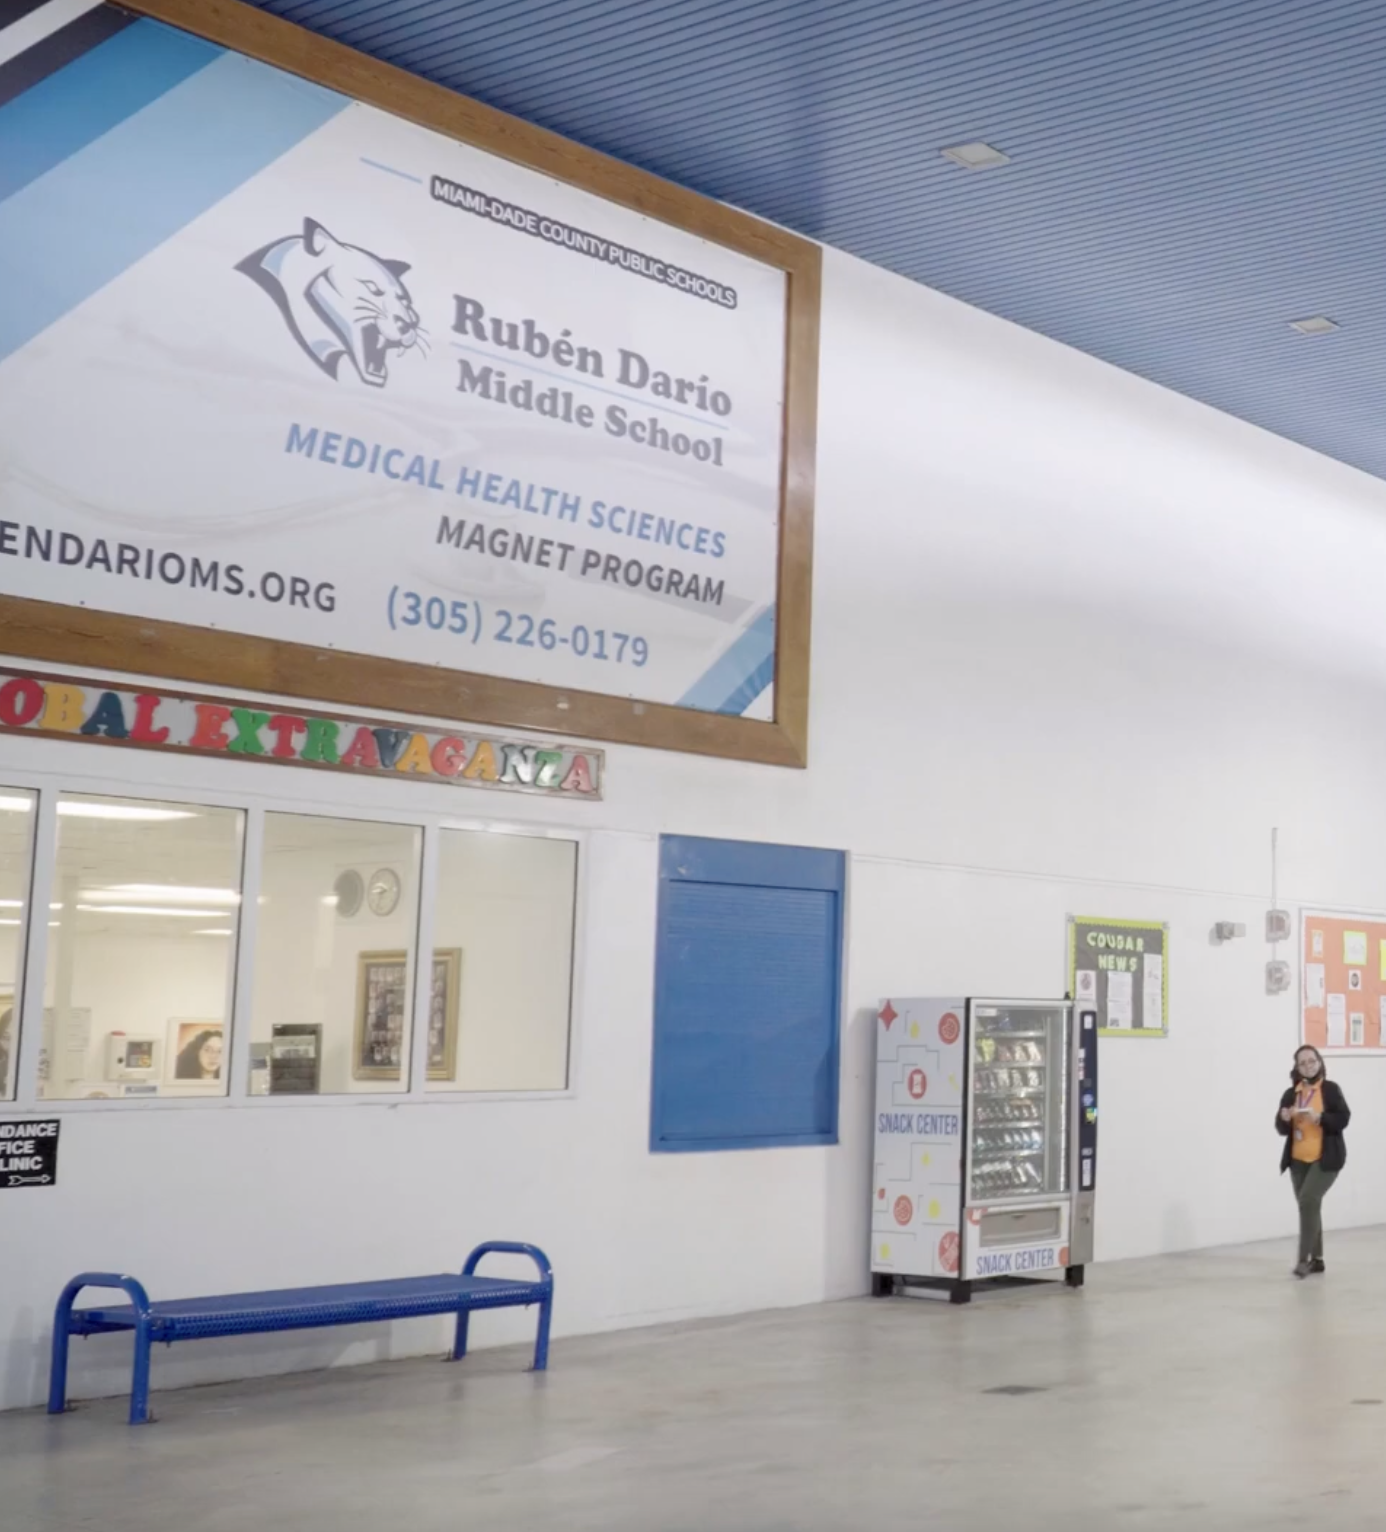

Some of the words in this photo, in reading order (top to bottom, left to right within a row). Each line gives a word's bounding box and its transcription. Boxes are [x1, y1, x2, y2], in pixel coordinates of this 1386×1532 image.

[434, 179, 538, 232] MIAMI-DADE
[540, 223, 606, 256] COUNTY
[609, 247, 664, 279] PUBLIC
[667, 268, 735, 305] SCHOOLS
[451, 294, 604, 378] Rubén
[616, 348, 731, 416] Darío
[456, 359, 594, 428] Middle
[604, 405, 723, 466] School
[284, 423, 444, 490] MEDICAL
[456, 466, 581, 523] HEALTH
[588, 501, 726, 558] SCIENCES
[0, 519, 336, 612] ENDARIOMS.ORG
[387, 585, 482, 644] (305)
[493, 610, 648, 667] 226-0179
[436, 515, 574, 571] MAGNET
[580, 549, 725, 606] PROGRAM
[0, 679, 169, 743] OBAL
[190, 704, 598, 792] EXTRAVAGANZA
[1086, 931, 1144, 952] COUGAR
[1098, 954, 1137, 972] NEWS
[878, 1113, 913, 1134] SNACK
[916, 1113, 959, 1136] CENTER
[976, 1253, 1012, 1276] SNACK
[1015, 1248, 1055, 1273] CENTER
